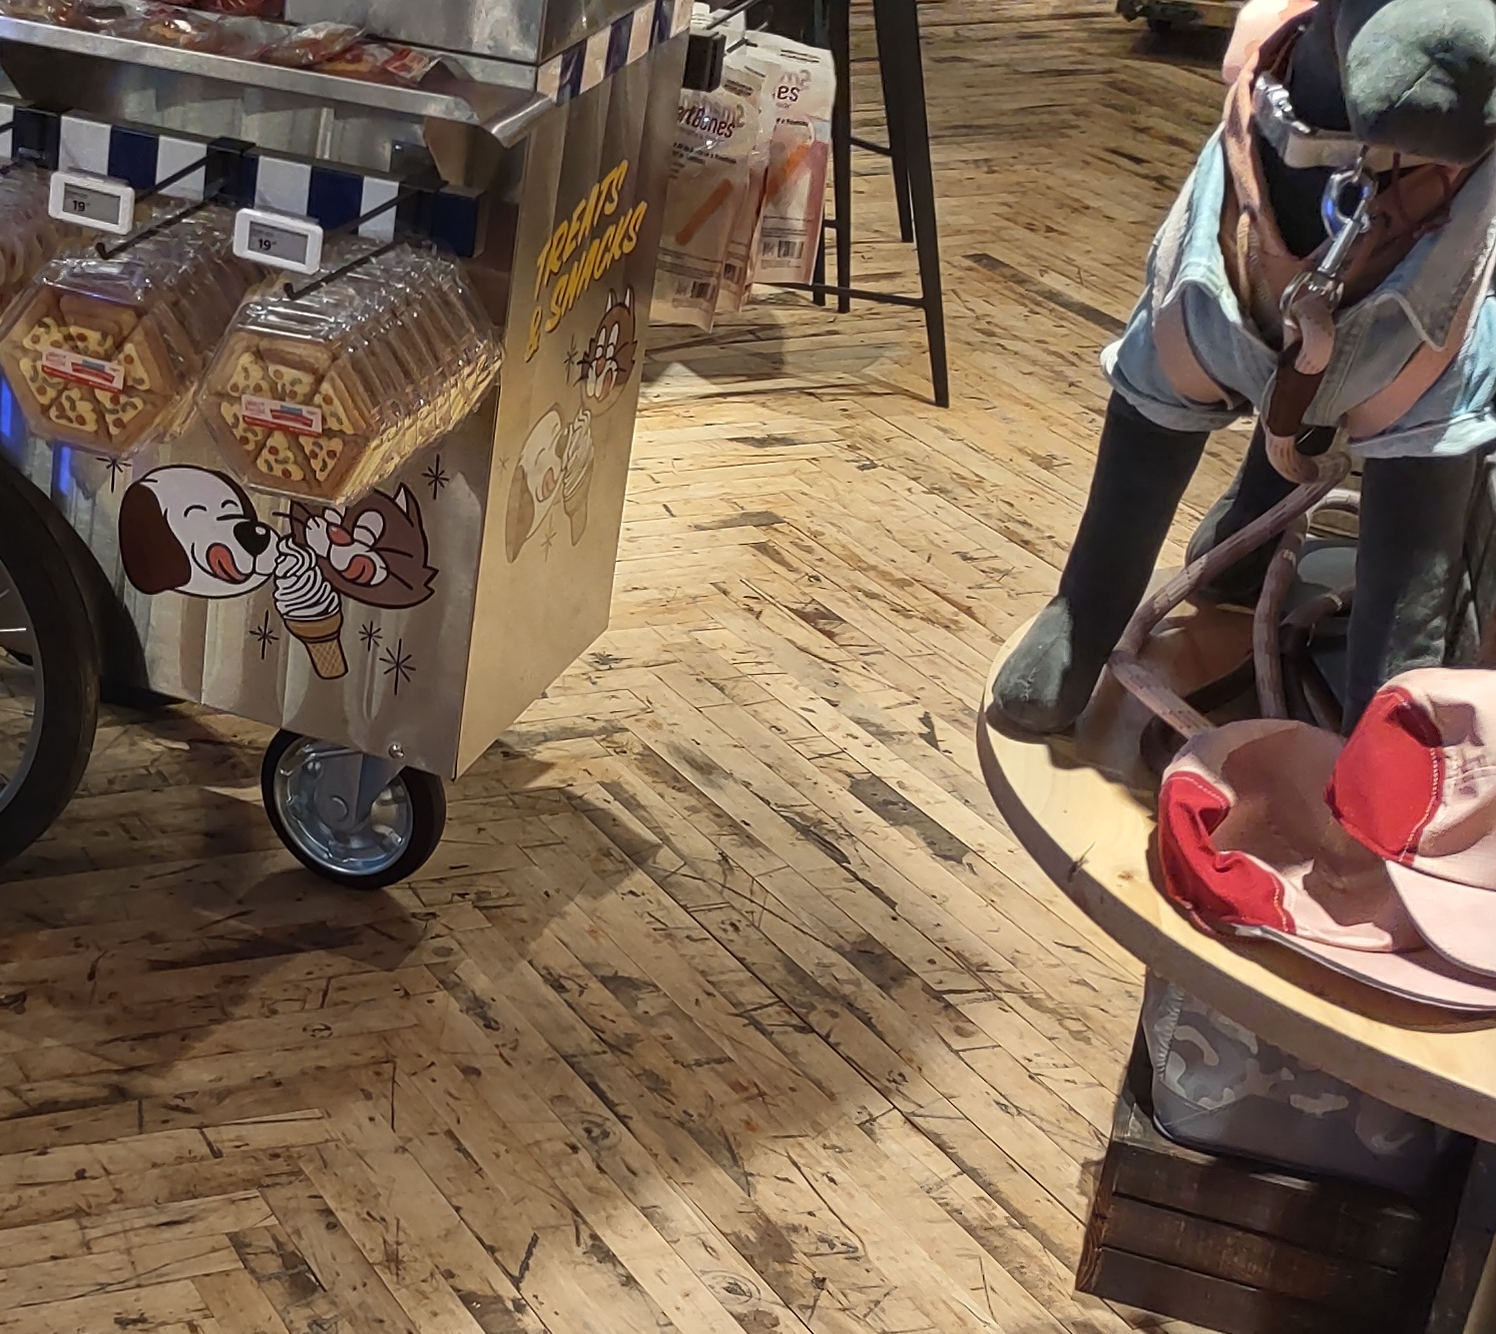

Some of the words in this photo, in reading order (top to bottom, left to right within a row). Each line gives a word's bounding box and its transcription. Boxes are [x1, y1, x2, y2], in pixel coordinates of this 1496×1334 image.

[524, 305, 543, 363] &
[545, 200, 648, 333] SNACKS
[534, 158, 629, 301] TREATS
